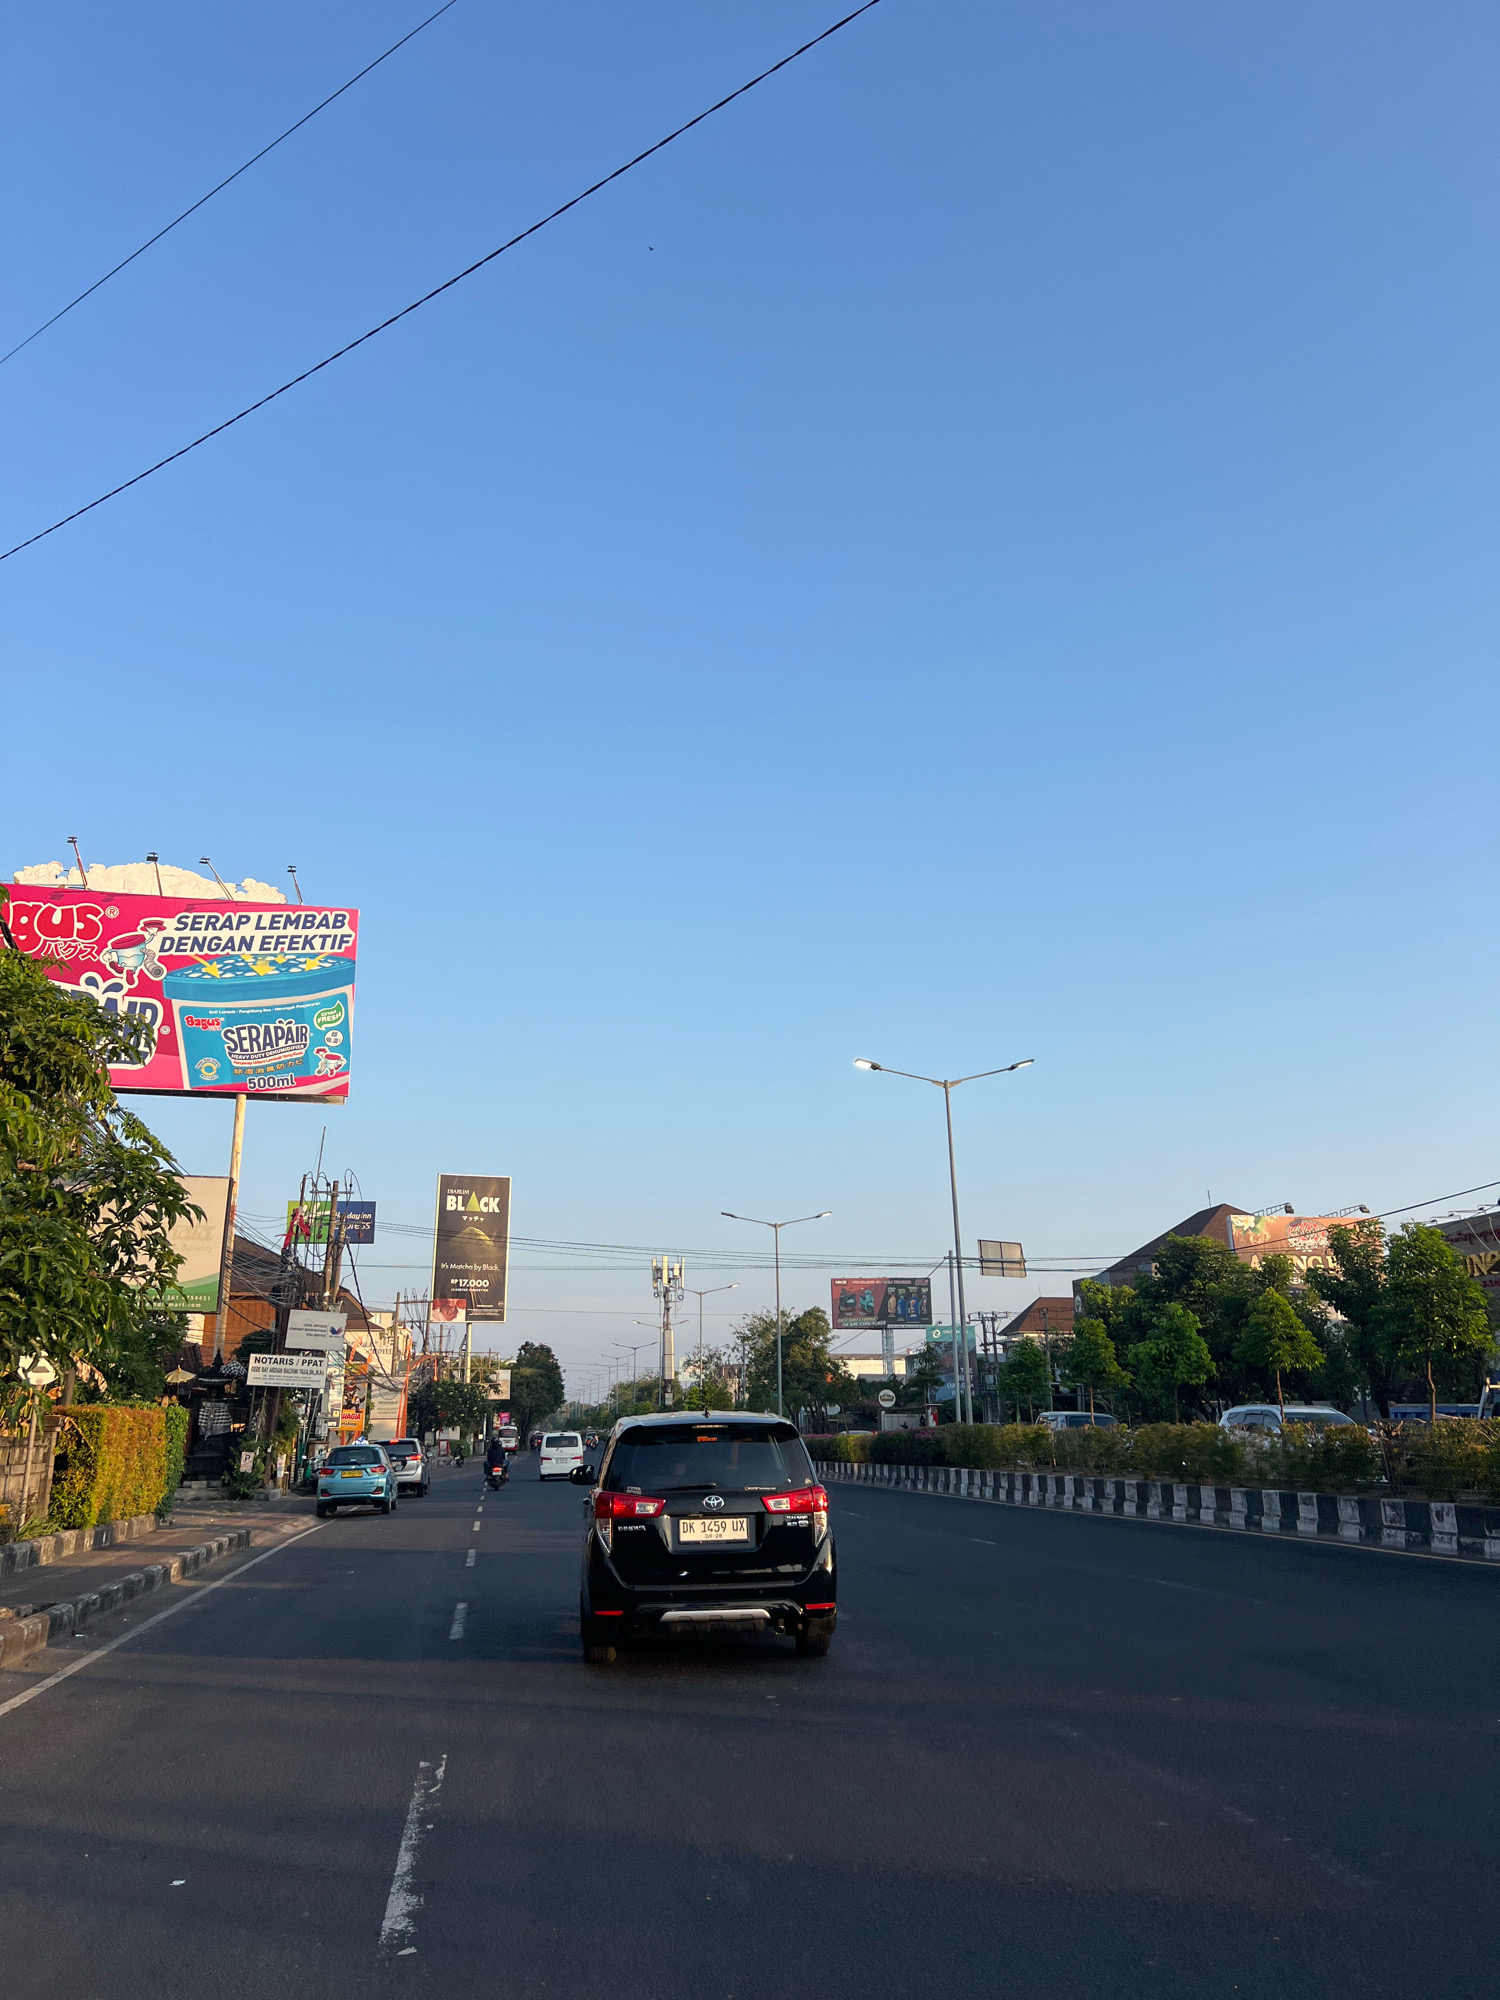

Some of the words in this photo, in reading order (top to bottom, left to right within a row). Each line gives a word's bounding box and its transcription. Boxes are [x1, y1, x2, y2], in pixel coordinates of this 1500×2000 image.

[174, 914, 251, 931] SERAP
[255, 913, 347, 931] LEMBAB
[41, 941, 99, 961] バグス
[158, 935, 256, 953] DENGAN
[258, 934, 353, 951] EFEKTIF
[185, 1015, 221, 1031] Bagus
[317, 1012, 341, 1024] FRESH
[223, 1024, 308, 1053] SERAPAIR
[265, 1045, 304, 1056] DEHUMIDIFIER
[248, 1074, 296, 1089] 500ml
[446, 1191, 500, 1213] BLACK
[474, 1263, 481, 1271] by
[459, 1279, 489, 1287] 17.000
[254, 1356, 294, 1366] NOTARIS
[301, 1358, 324, 1367] PPAT
[682, 1522, 696, 1534] DK
[701, 1521, 726, 1533] 1459
[732, 1520, 745, 1532] UX
